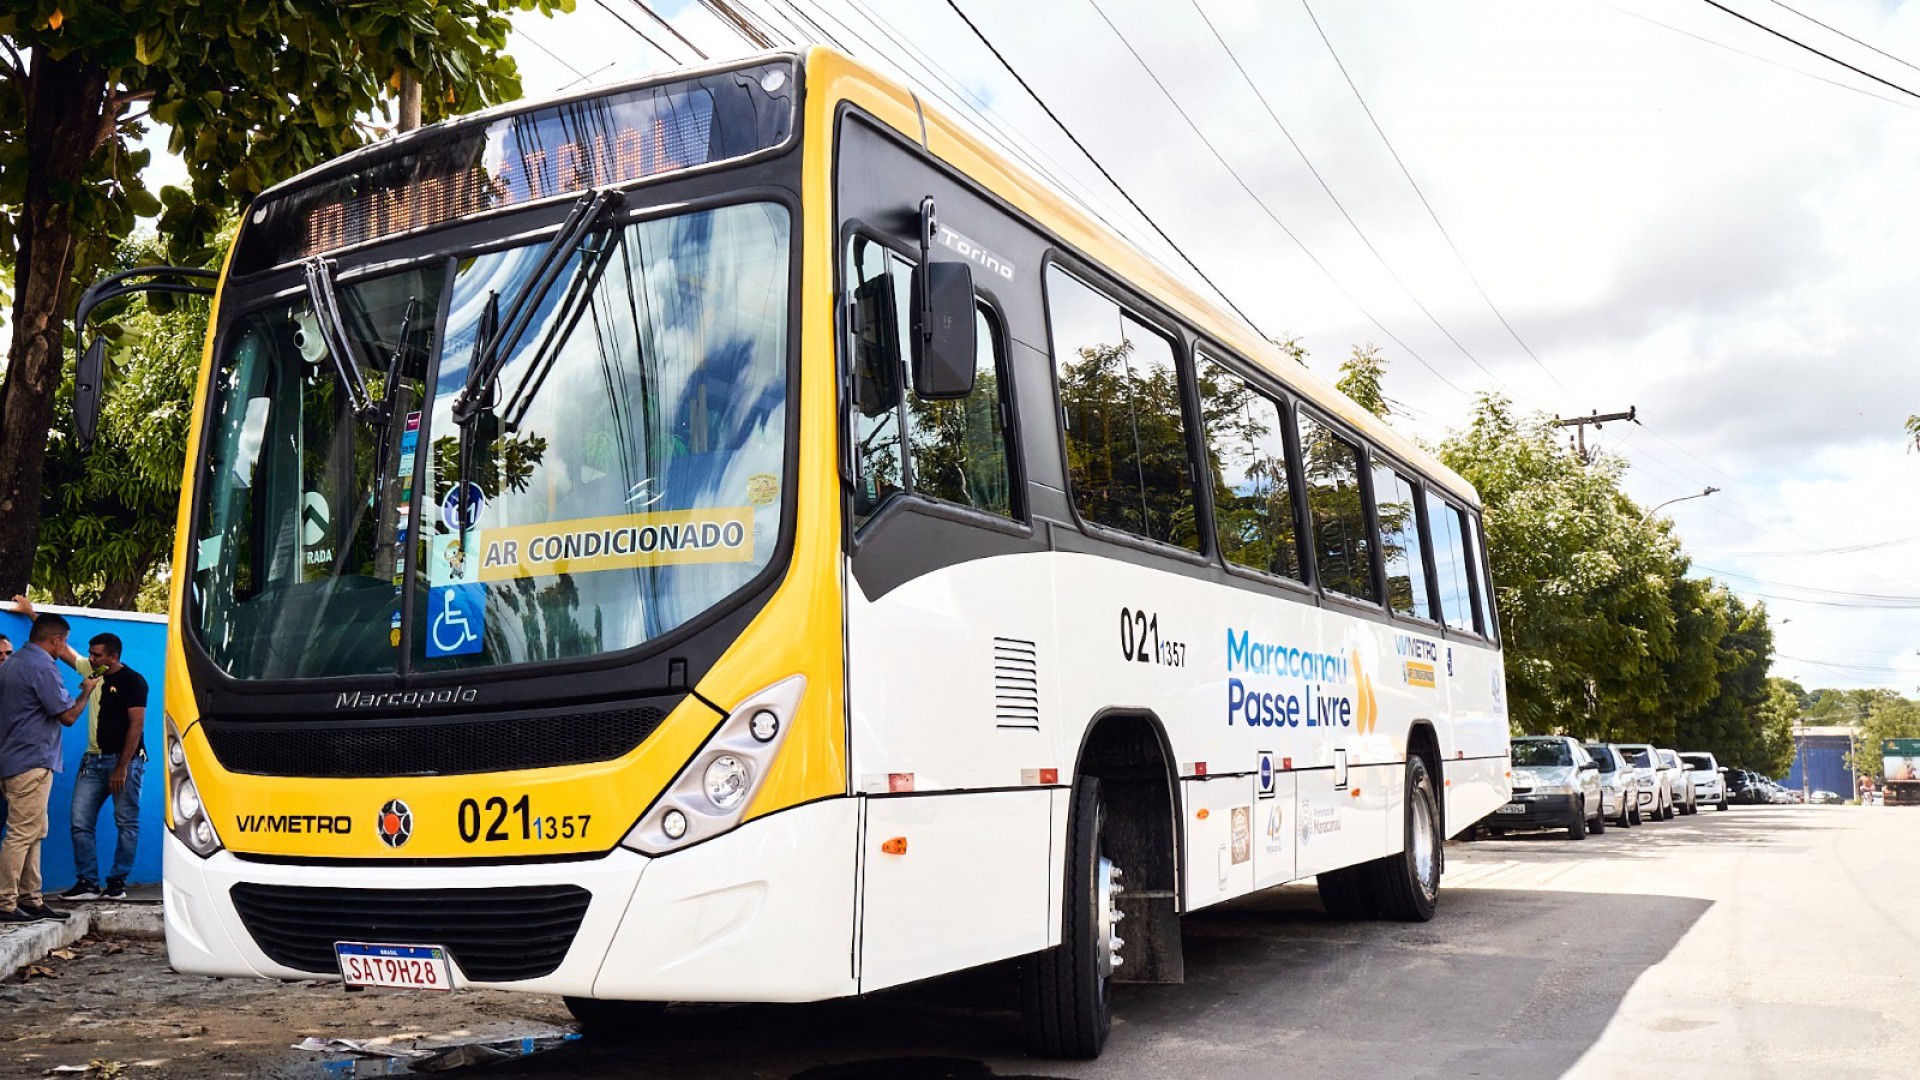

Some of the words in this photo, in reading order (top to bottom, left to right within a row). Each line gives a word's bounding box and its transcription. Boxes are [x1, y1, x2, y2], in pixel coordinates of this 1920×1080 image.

[941, 227, 1012, 279] Torino
[306, 549, 333, 564] RADA
[484, 541, 518, 568] AR
[528, 520, 744, 562] CONDICIONADO
[1120, 606, 1160, 664] 021
[1160, 640, 1186, 667] 1357
[1227, 627, 1347, 684] Maracanaú
[335, 685, 477, 709] Marcopolo
[1228, 677, 1300, 728] Passe
[1306, 683, 1351, 728] Livre
[236, 815, 352, 834] VIAMETRO
[458, 794, 530, 843] 021
[533, 814, 591, 840] 1357
[349, 957, 437, 984] SAT9H28
